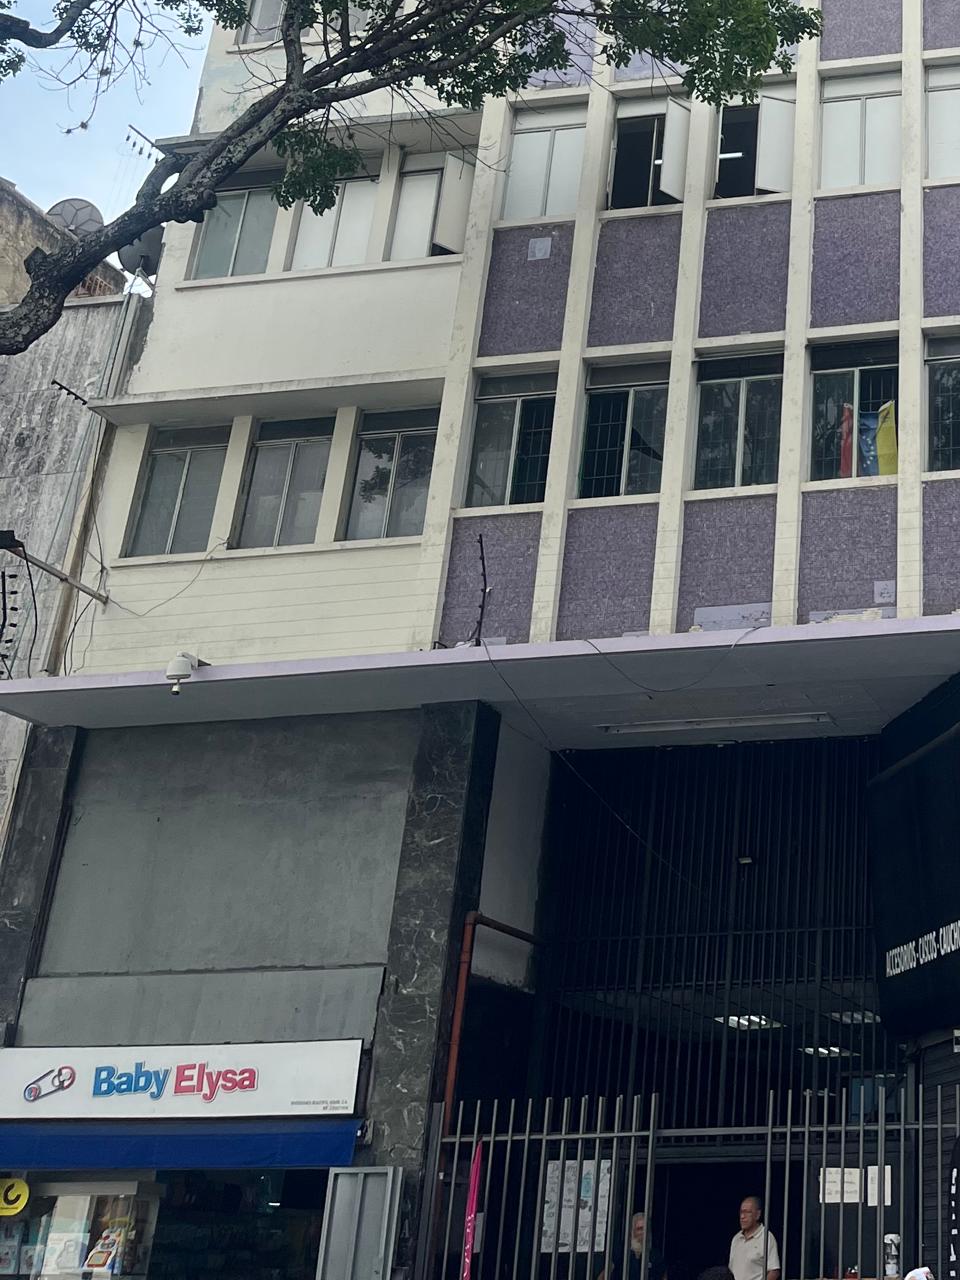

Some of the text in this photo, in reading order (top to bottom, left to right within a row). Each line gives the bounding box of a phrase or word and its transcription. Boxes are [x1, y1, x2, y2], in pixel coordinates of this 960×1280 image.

[886, 940, 916, 977] ACCESORIOS
[919, 928, 937, 964] CASCOS
[93, 1061, 257, 1102] Baby Elysa
